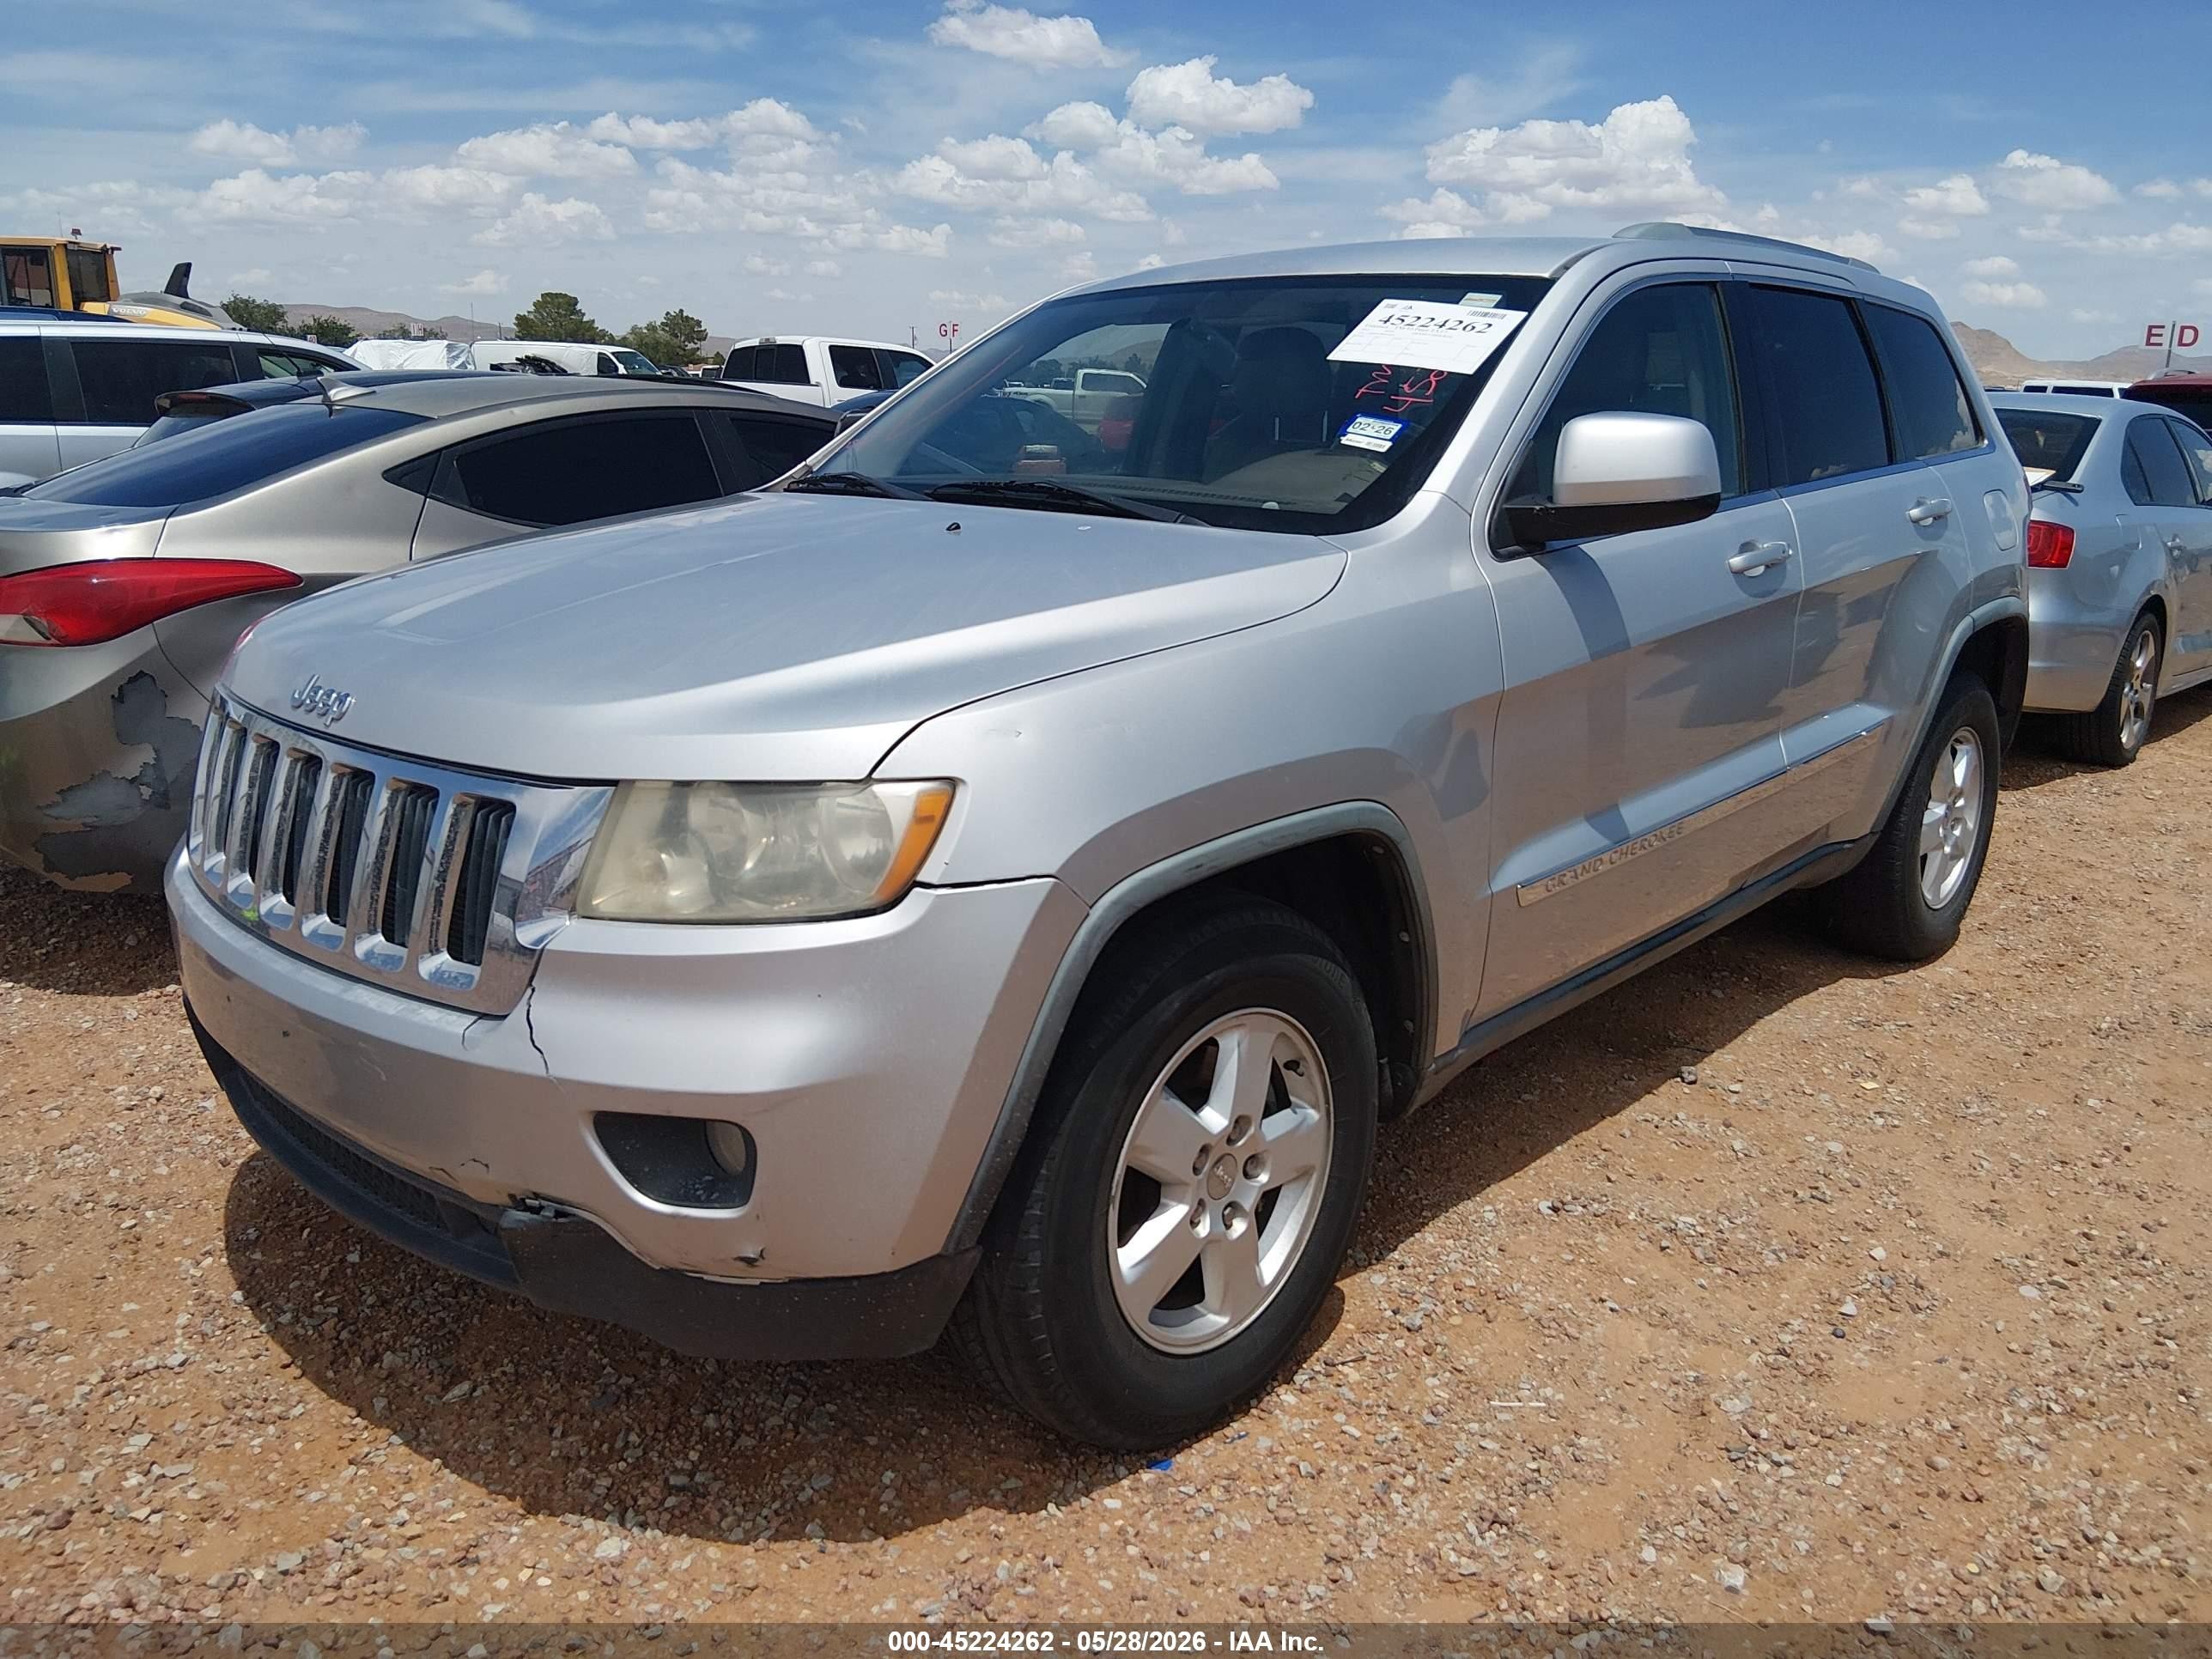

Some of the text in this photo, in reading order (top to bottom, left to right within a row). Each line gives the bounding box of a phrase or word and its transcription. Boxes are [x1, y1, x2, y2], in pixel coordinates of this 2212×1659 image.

[112, 307, 147, 316] VOLVO
[939, 323, 959, 337] G F
[1378, 313, 1493, 334] 45224262
[2145, 325, 2199, 347] E D
[290, 673, 356, 729] Jeep
[1545, 822, 1685, 894] GRAND CHEROKEE
